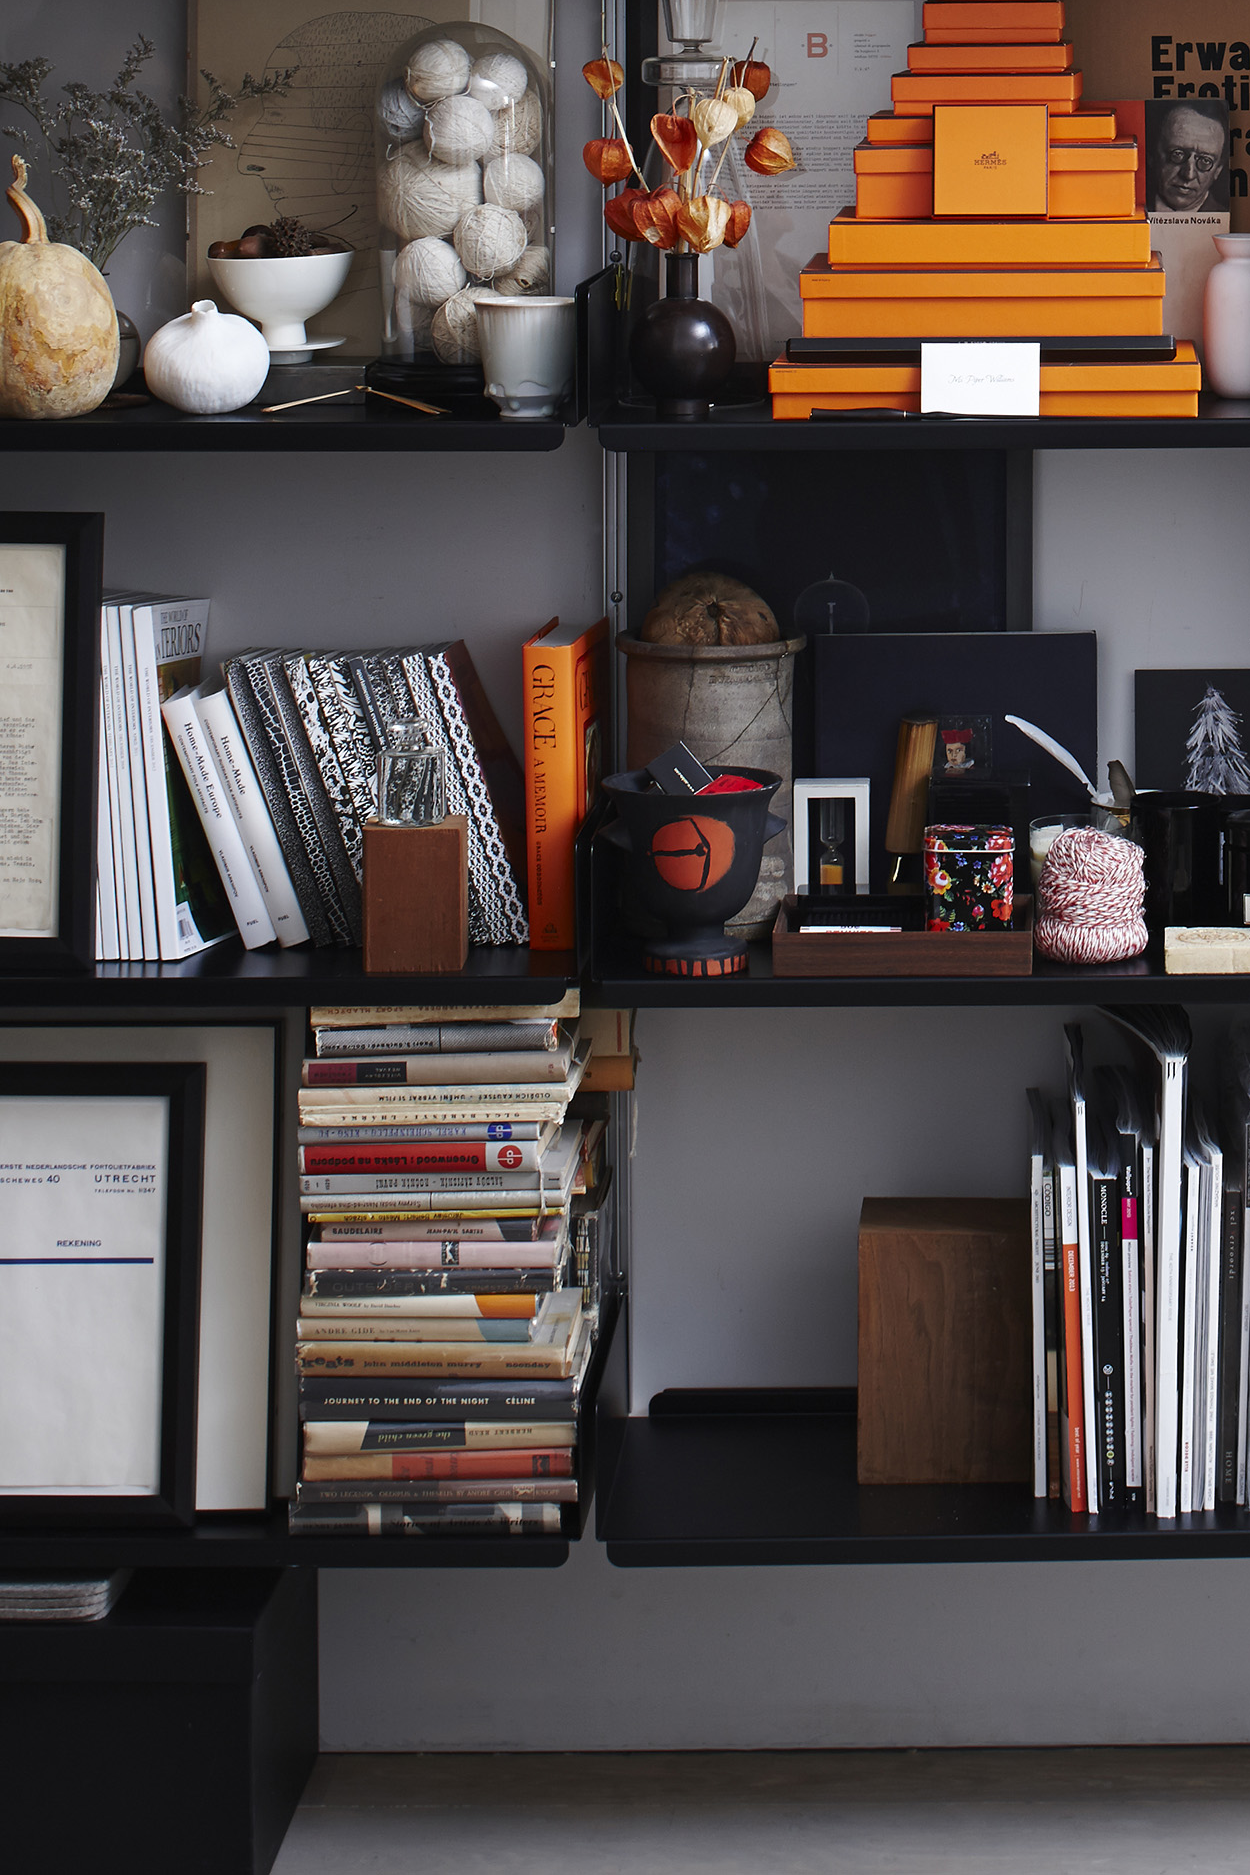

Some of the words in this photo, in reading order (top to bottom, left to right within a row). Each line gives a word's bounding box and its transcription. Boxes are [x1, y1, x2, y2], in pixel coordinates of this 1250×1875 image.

[806, 32, 829, 59] B
[1190, 215, 1222, 225] Nováka
[531, 663, 557, 751] GRACE
[533, 757, 545, 768] A
[204, 780, 224, 820] Europe
[533, 771, 548, 835] MEMOIR
[310, 1153, 356, 1167] podporu
[357, 1158, 372, 1167] na
[374, 1156, 408, 1167] Láska
[416, 1155, 480, 1166] Greenwood
[46, 1174, 61, 1184] 40
[94, 1174, 157, 1183] UTRECHT
[1100, 1184, 1109, 1224] MONOCLE
[56, 1239, 102, 1247] REKENING
[363, 1360, 386, 1369] john
[447, 1361, 483, 1369] murry
[505, 1361, 552, 1369] noonday
[323, 1397, 365, 1405] JOURNEY
[368, 1397, 380, 1405] TO
[383, 1397, 399, 1405] THE
[403, 1397, 422, 1405] END
[426, 1397, 437, 1405] OF
[440, 1397, 457, 1405] THE
[460, 1397, 490, 1405] NIGHT
[505, 1395, 536, 1405] CÉLINE
[376, 1433, 403, 1443] child
